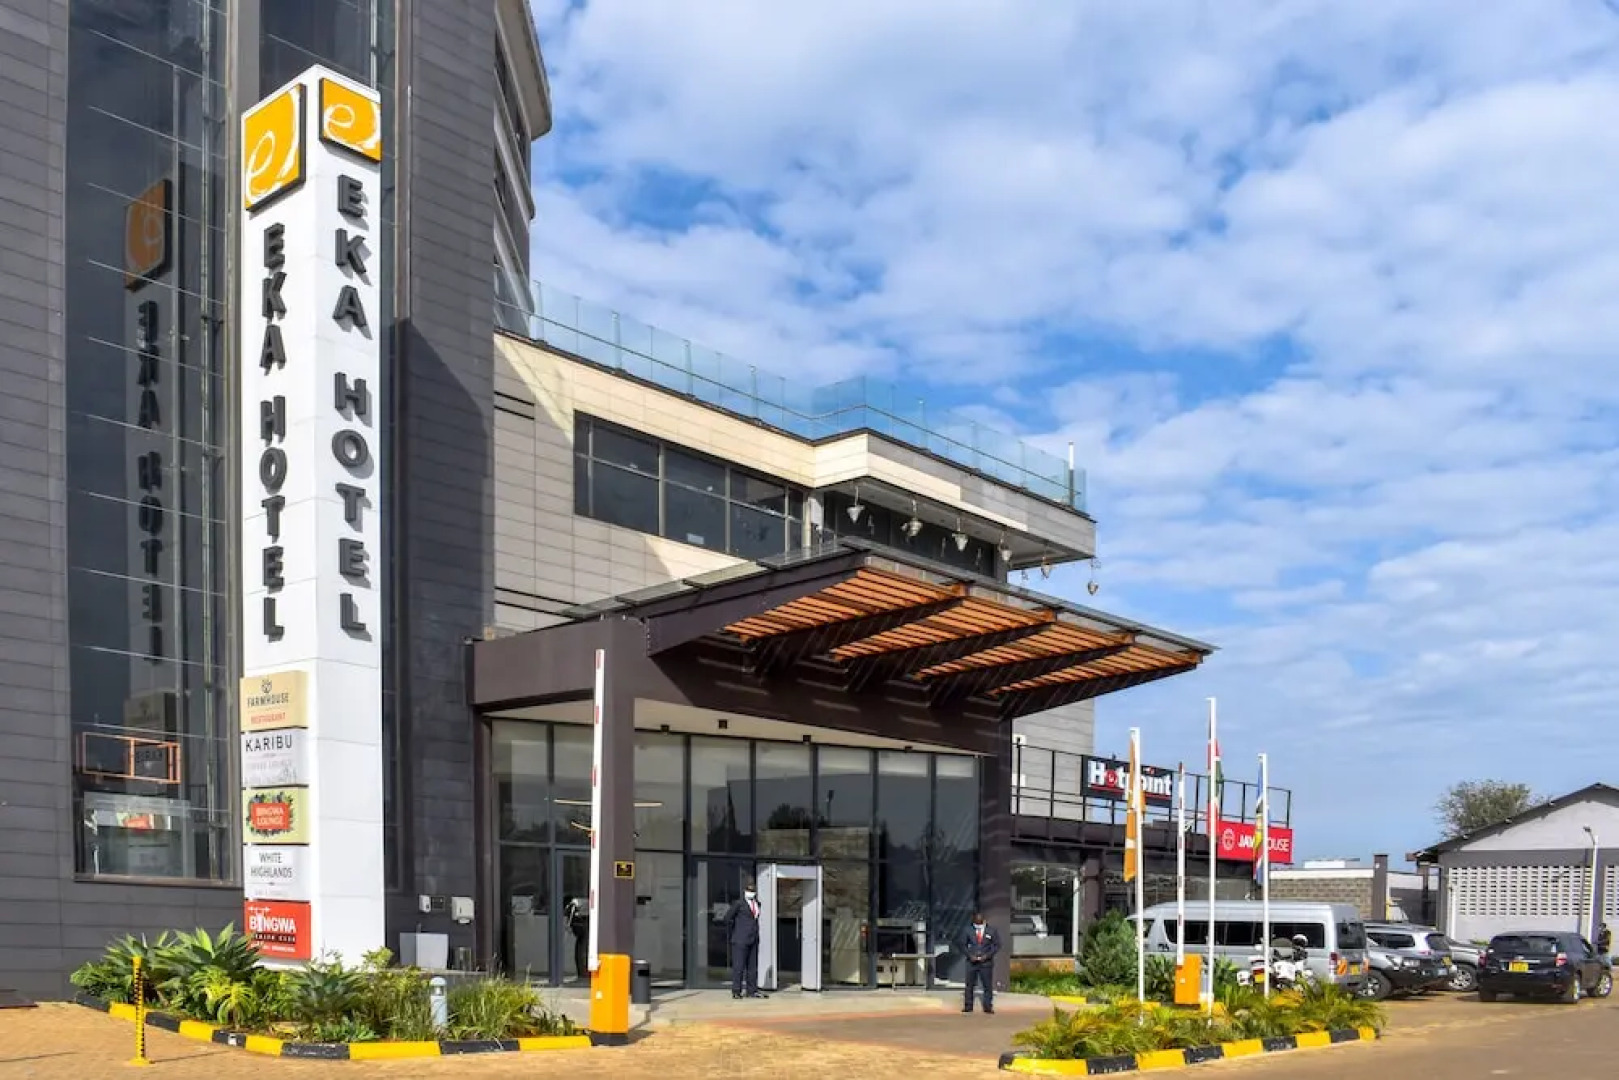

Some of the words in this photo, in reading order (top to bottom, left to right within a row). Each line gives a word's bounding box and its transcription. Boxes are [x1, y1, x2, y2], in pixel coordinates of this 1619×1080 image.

[333, 174, 367, 328] EKA
[261, 222, 287, 371] EKA
[331, 372, 370, 633] HOTEL
[259, 395, 287, 639] HOTEL
[247, 692, 289, 708] FARMHOUSE
[245, 734, 293, 753] KARIBU
[258, 851, 283, 864] WHITE
[250, 865, 293, 879] HIGHLANDS
[249, 914, 297, 934] BINGWA
